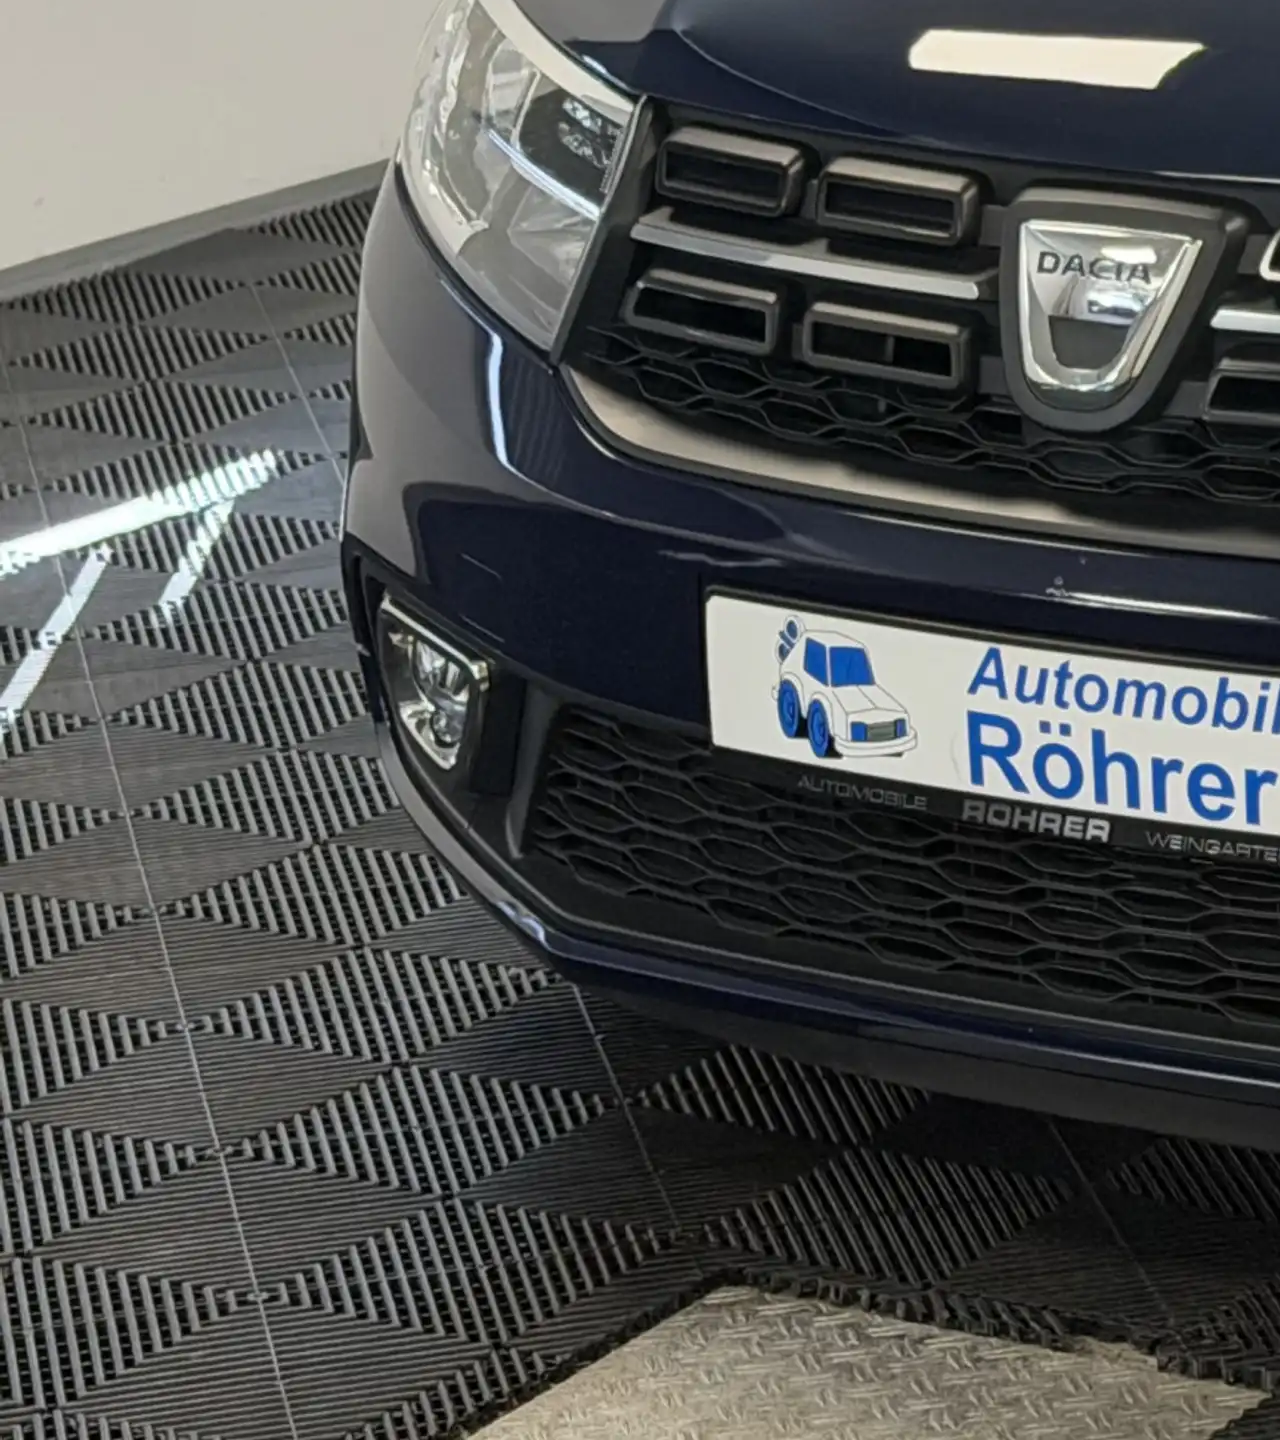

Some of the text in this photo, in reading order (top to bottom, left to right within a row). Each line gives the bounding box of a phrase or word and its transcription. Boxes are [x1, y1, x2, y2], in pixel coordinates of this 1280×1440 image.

[1036, 251, 1152, 285] DACIA
[966, 709, 1279, 826] Röhrer
[797, 774, 929, 811] AUTOMOBILE
